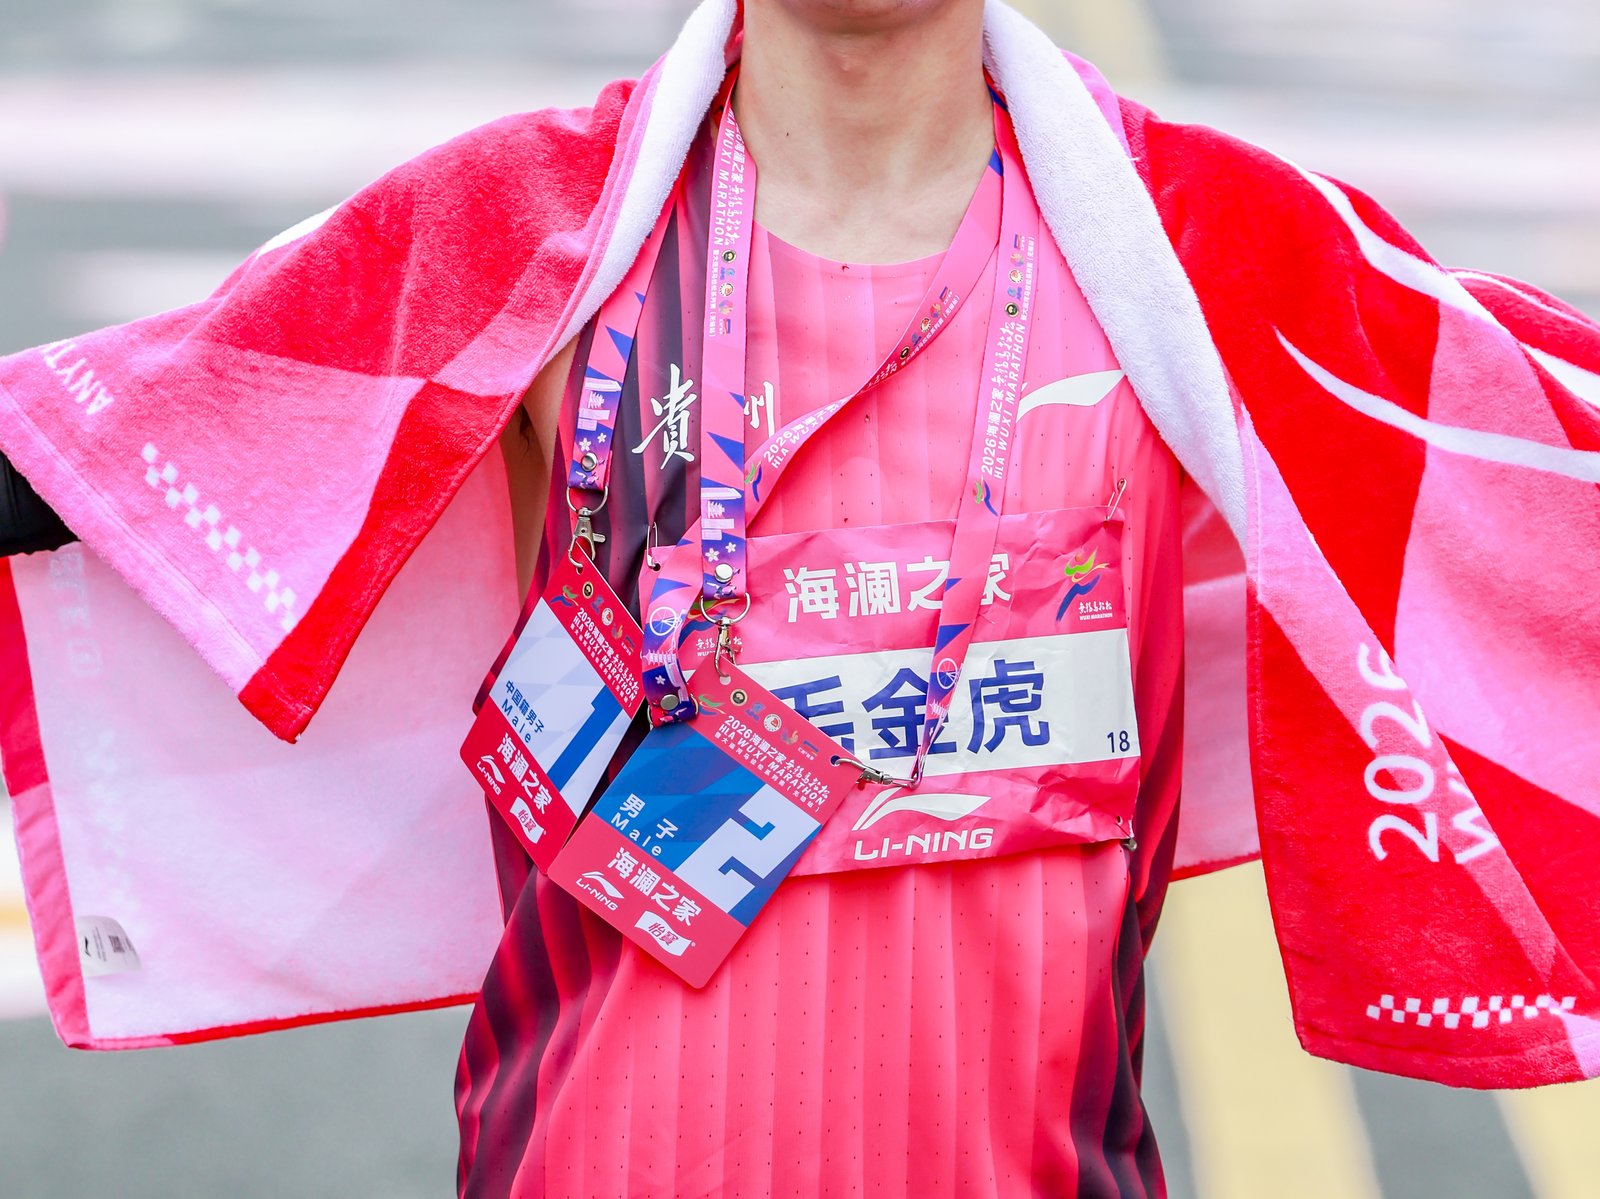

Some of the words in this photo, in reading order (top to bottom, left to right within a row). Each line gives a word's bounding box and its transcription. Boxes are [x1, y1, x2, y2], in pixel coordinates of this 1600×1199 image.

[720, 128, 735, 165] WUXI
[713, 169, 730, 246] MARATHON
[1005, 323, 1026, 405] MARATHON
[997, 409, 1013, 451] WUXI
[771, 447, 789, 469] HLA
[994, 457, 1005, 479] HLA
[573, 615, 584, 631] HLA
[584, 631, 603, 655] WUXI
[601, 655, 636, 701] MARATHON
[502, 699, 532, 743] Male
[505, 680, 545, 734] 中国籍男子
[546, 685, 623, 792] 1
[1107, 730, 1130, 753] 18
[476, 761, 502, 796] LI-NING
[496, 732, 553, 814] 海澜之家
[718, 724, 736, 740] HLA
[737, 737, 767, 762] WUXI
[767, 761, 826, 806] MARATHON
[610, 812, 662, 856] Male
[673, 783, 822, 914] 2
[854, 828, 994, 860] LI-NING
[575, 878, 618, 911] LI-NING
[607, 846, 702, 926] 海澜之家
